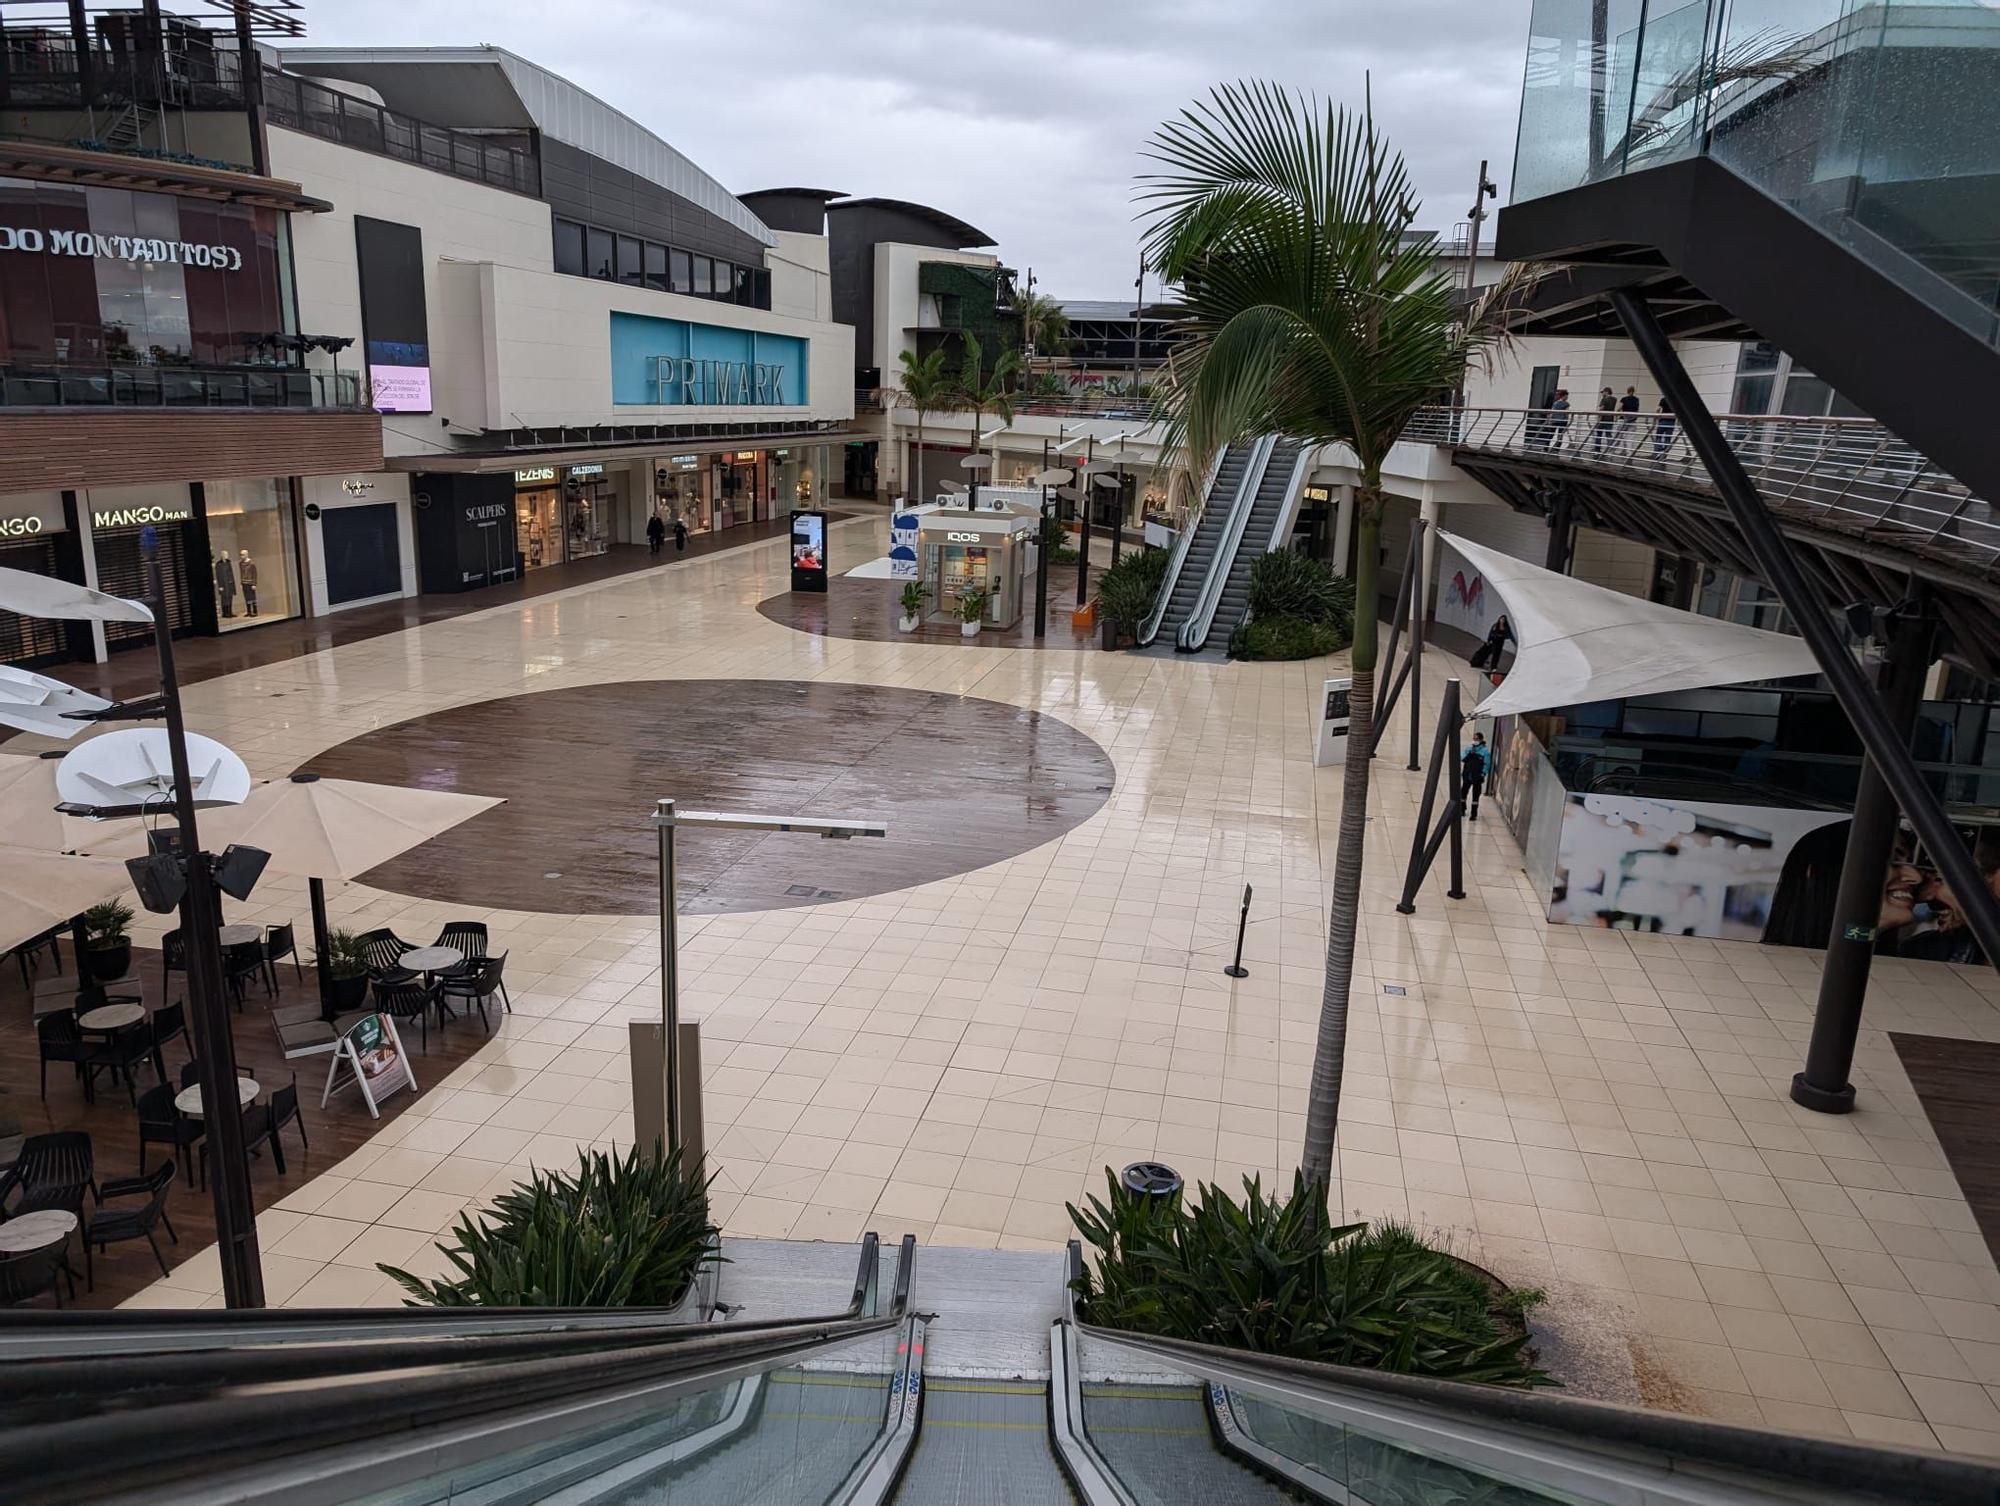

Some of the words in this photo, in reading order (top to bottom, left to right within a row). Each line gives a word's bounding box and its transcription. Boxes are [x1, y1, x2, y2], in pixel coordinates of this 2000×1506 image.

[656, 354, 785, 406] PRIMARK
[571, 464, 604, 476] CALZEDONIA
[94, 505, 164, 528] MANGO
[165, 510, 188, 521] MAN
[465, 503, 507, 522] SCALPERS
[947, 531, 980, 543] IQOS
